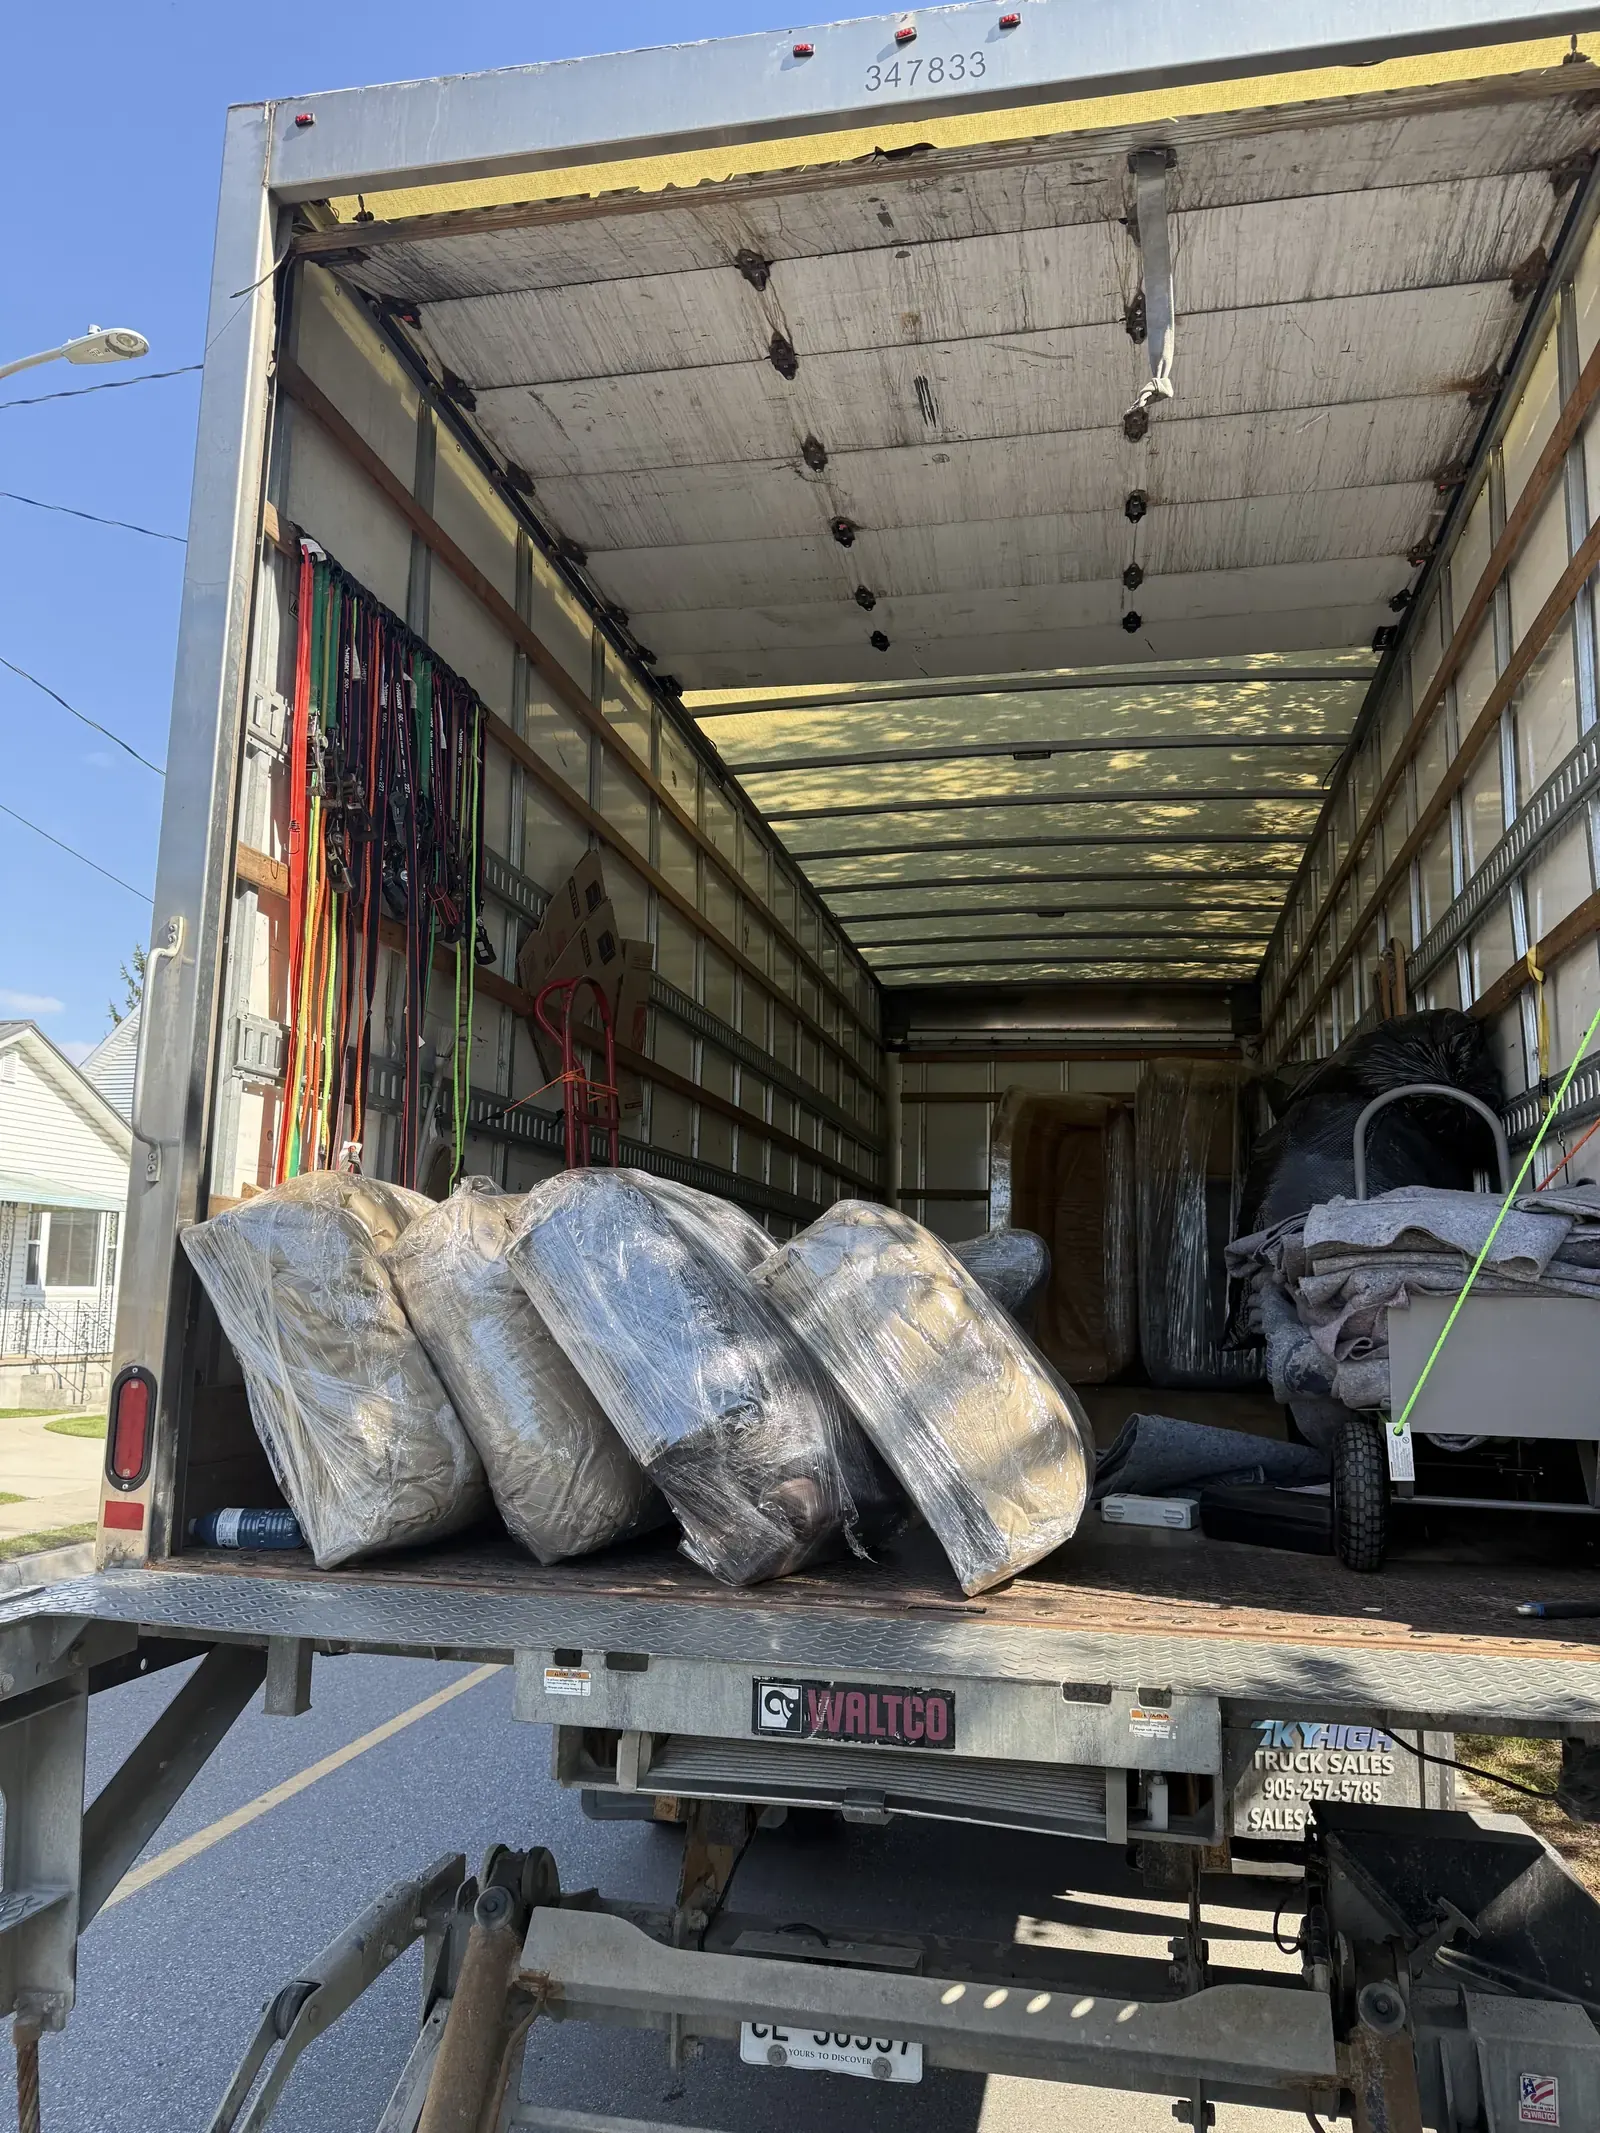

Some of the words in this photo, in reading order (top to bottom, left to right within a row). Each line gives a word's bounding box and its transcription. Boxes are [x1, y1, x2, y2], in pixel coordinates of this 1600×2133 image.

[864, 50, 987, 92] 347833
[807, 1689, 948, 1741] WALTCO
[1254, 1750, 1325, 1773] TRUCK
[1327, 1753, 1395, 1775] SALES
[1263, 1777, 1383, 1803] 905-257-5785
[1250, 1807, 1305, 1830] SALES
[788, 2048, 815, 2059] YOURS
[818, 2052, 829, 2061] TO
[831, 2054, 873, 2066] DISCOVER
[1530, 2111, 1555, 2121] WALTCO
